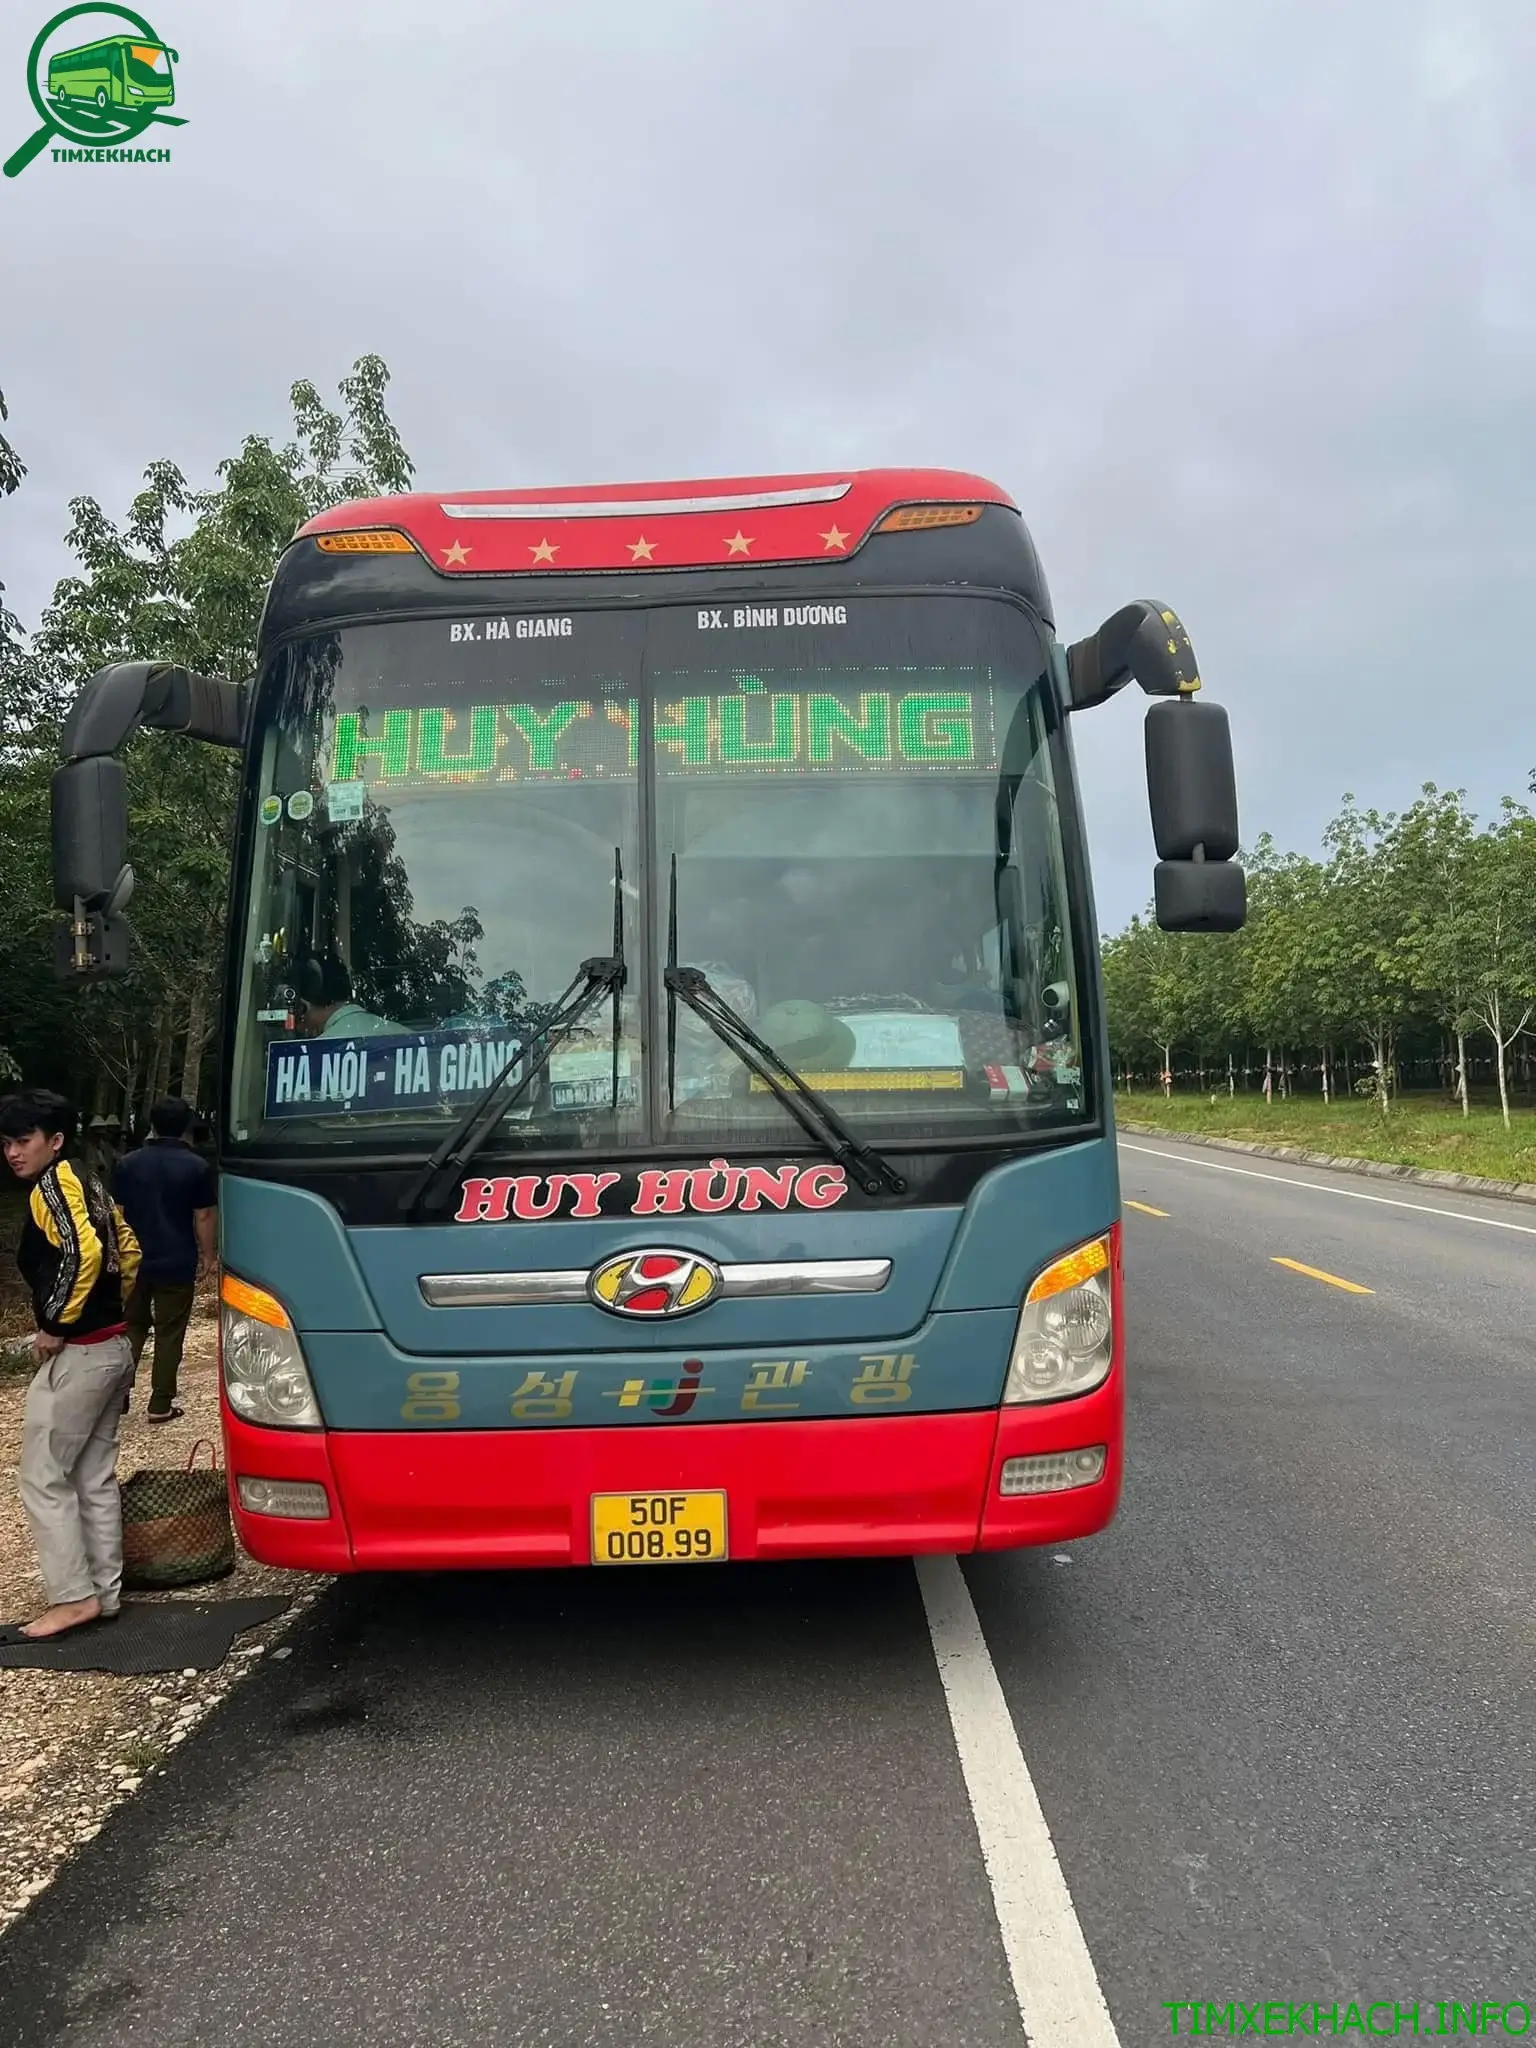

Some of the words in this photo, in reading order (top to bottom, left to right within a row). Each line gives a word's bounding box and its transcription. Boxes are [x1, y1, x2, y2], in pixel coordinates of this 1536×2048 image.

[450, 623, 481, 642] BX.
[485, 616, 511, 640] HÀ
[516, 617, 572, 639] GIANG
[697, 610, 729, 629] BX.
[733, 605, 778, 628] BÌNH
[783, 605, 848, 626] DƯƠNG
[331, 700, 593, 780] HUY
[627, 675, 975, 767] HÙNG
[275, 1045, 311, 1103] HÀ
[321, 1041, 368, 1109] NỘI
[394, 1036, 430, 1095] HÀ
[440, 1039, 522, 1091] GIANG
[454, 1171, 621, 1222] HUY
[631, 1157, 849, 1214] HÙNG
[630, 1497, 687, 1526] 50F
[607, 1528, 712, 1560] 008.99
